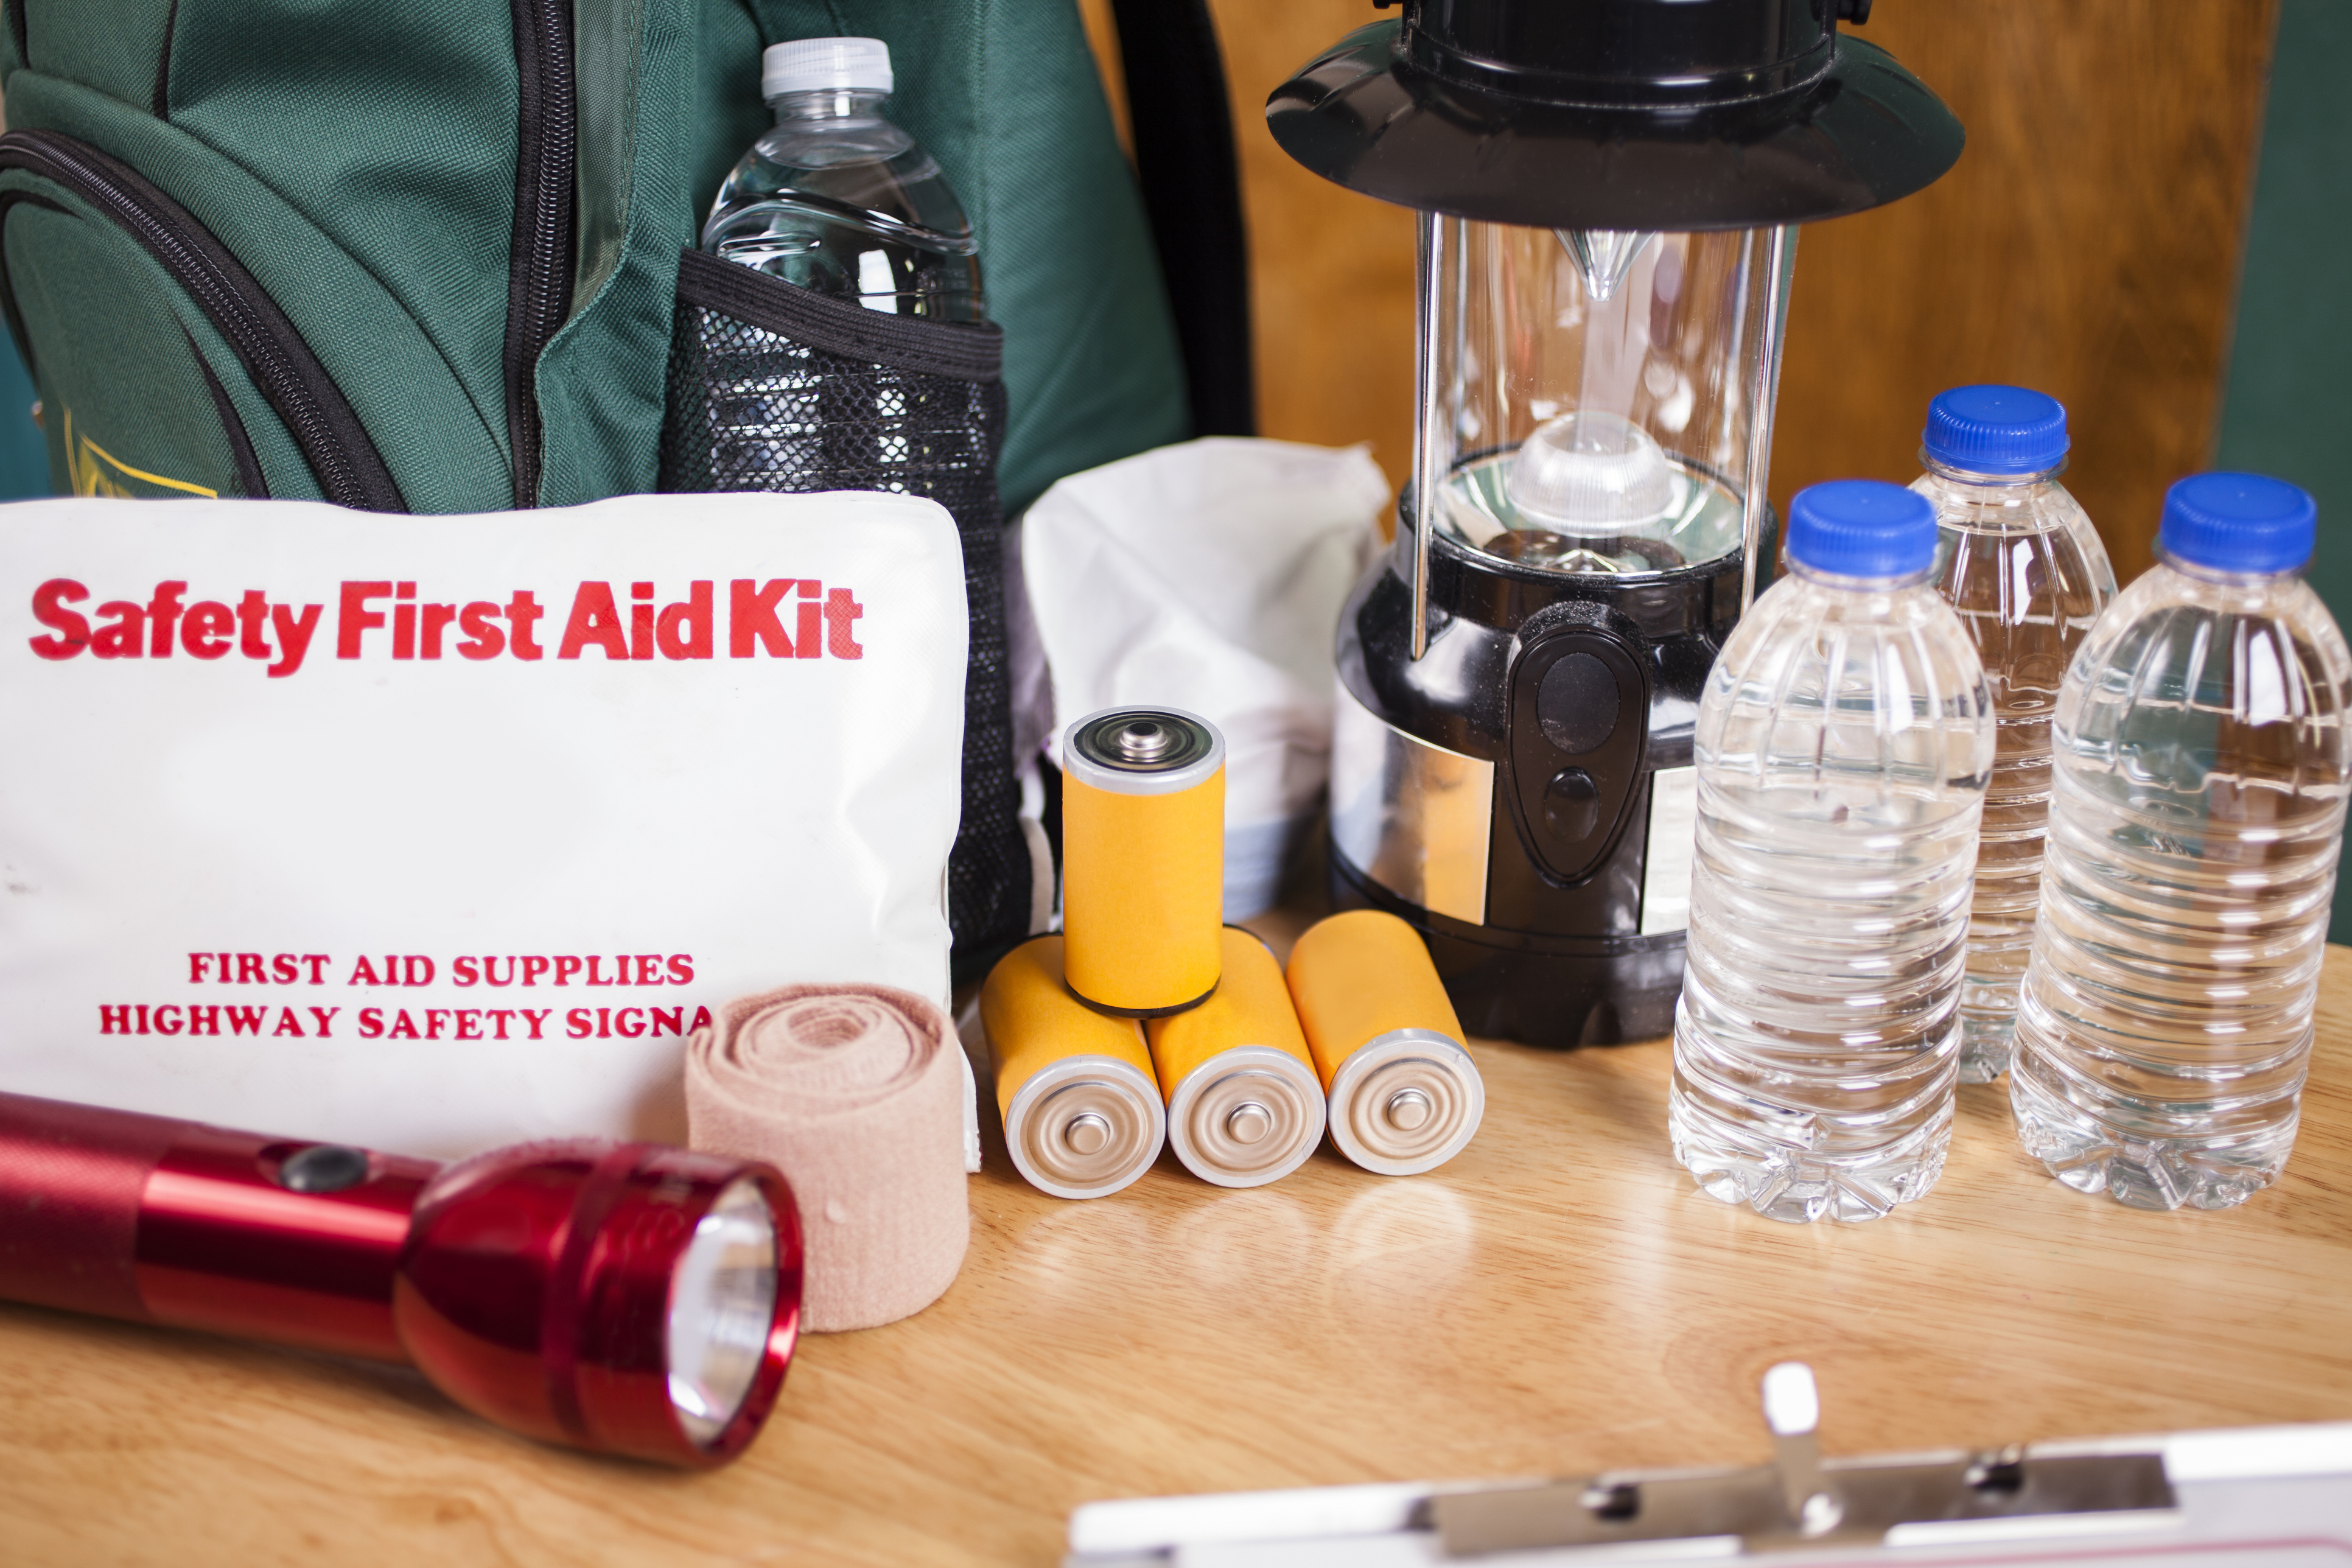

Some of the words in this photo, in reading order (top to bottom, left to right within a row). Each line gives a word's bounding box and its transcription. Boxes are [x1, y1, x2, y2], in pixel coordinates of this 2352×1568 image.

[30, 579, 323, 677] Safety
[337, 581, 543, 660] First
[559, 580, 713, 660] Aid
[730, 579, 863, 659] Kit
[189, 953, 330, 985] FIRST
[349, 955, 435, 986] AID
[453, 954, 694, 987] SUPPLIES
[99, 1004, 338, 1038] HIGHWAY
[359, 1008, 551, 1040] SAFETY
